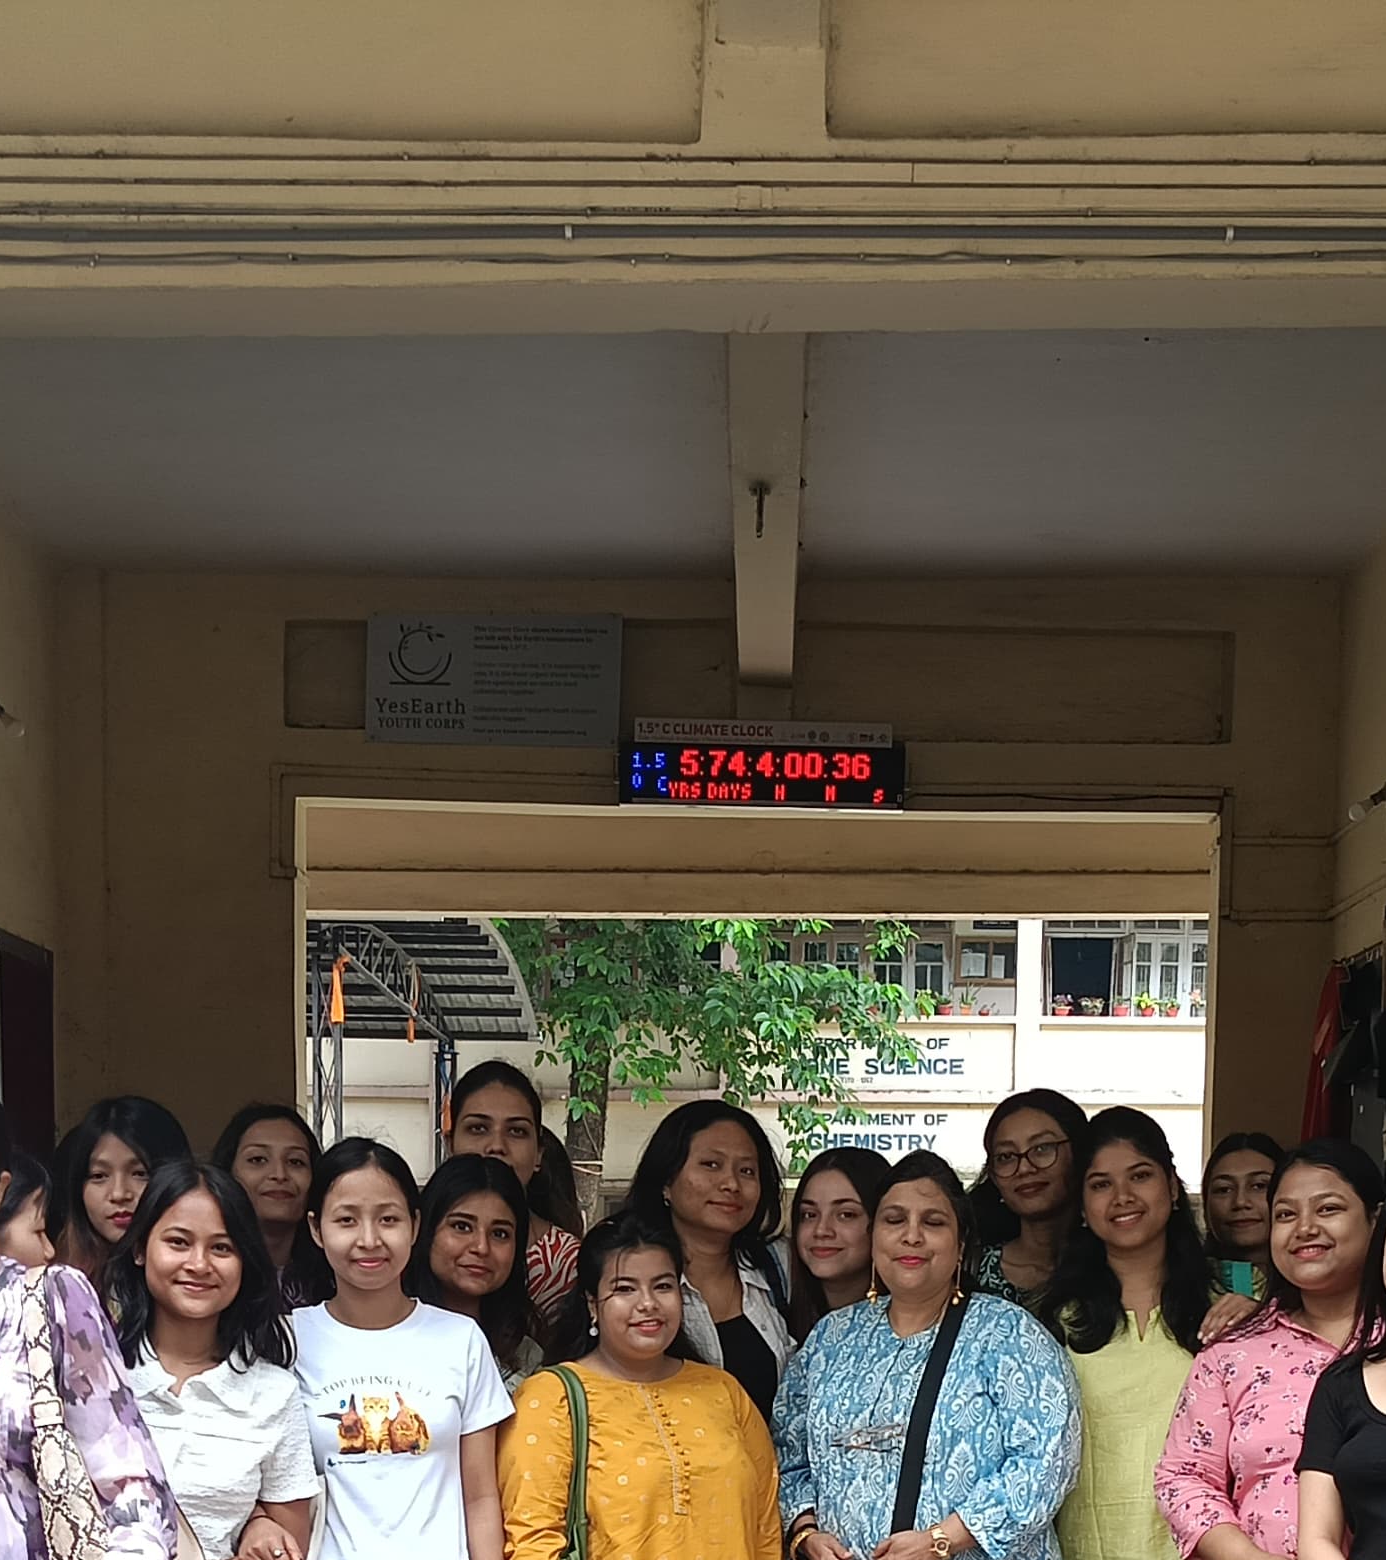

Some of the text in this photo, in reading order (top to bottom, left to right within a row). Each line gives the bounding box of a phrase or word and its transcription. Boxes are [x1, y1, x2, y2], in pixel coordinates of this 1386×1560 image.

[375, 698, 466, 715] YesEarth
[377, 717, 465, 730] YOUTH CORPS
[673, 723, 729, 736] CLIMATE
[731, 725, 774, 737] CLOCK
[669, 782, 701, 798] YRS
[707, 783, 752, 800] DAYS
[926, 1037, 951, 1050] OF
[864, 1058, 965, 1076] SCIENCE
[821, 1113, 948, 1126] PARTMENT OF
[806, 1133, 938, 1151] CHEMISTRY
